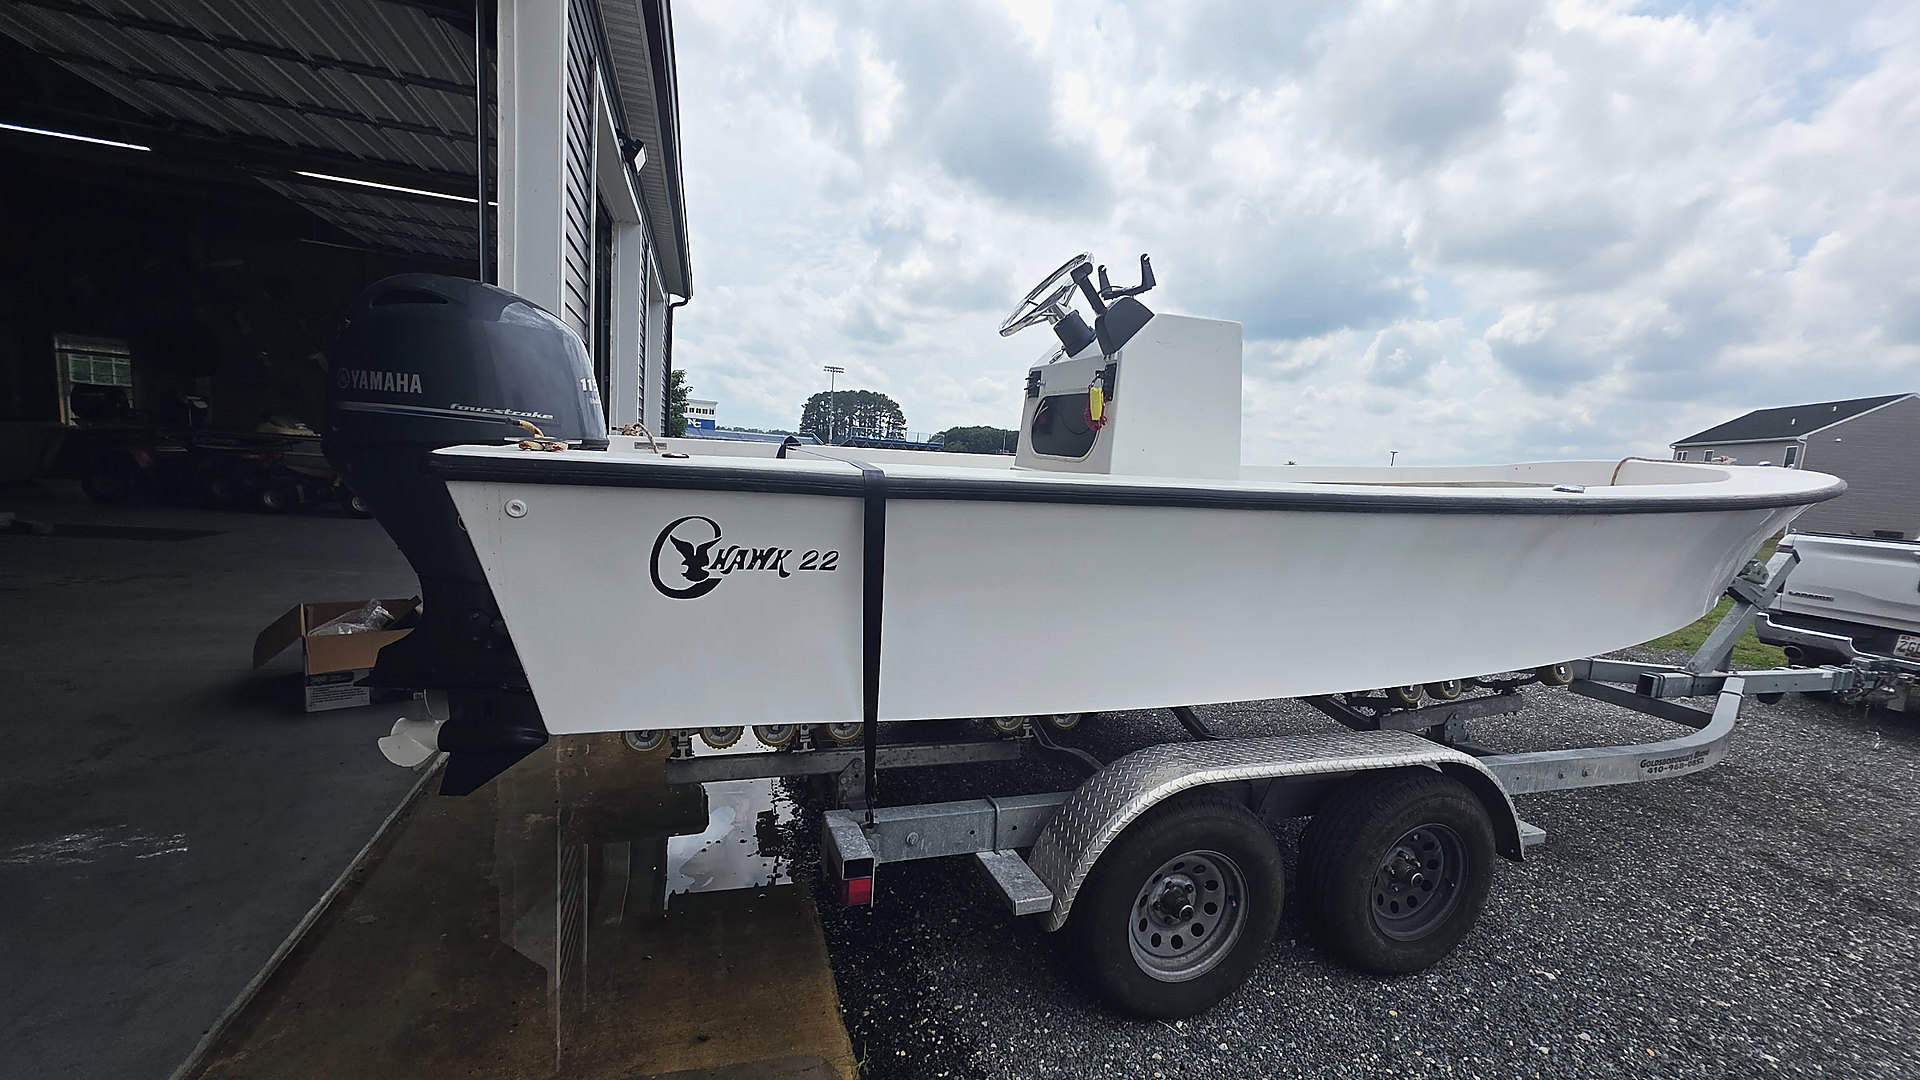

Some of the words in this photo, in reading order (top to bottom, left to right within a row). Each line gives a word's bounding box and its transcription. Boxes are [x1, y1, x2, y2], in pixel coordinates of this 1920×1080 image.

[351, 370, 423, 394] YAMAHA
[687, 418, 702, 428] NC
[708, 544, 793, 579] HAWK
[799, 550, 840, 572] 22
